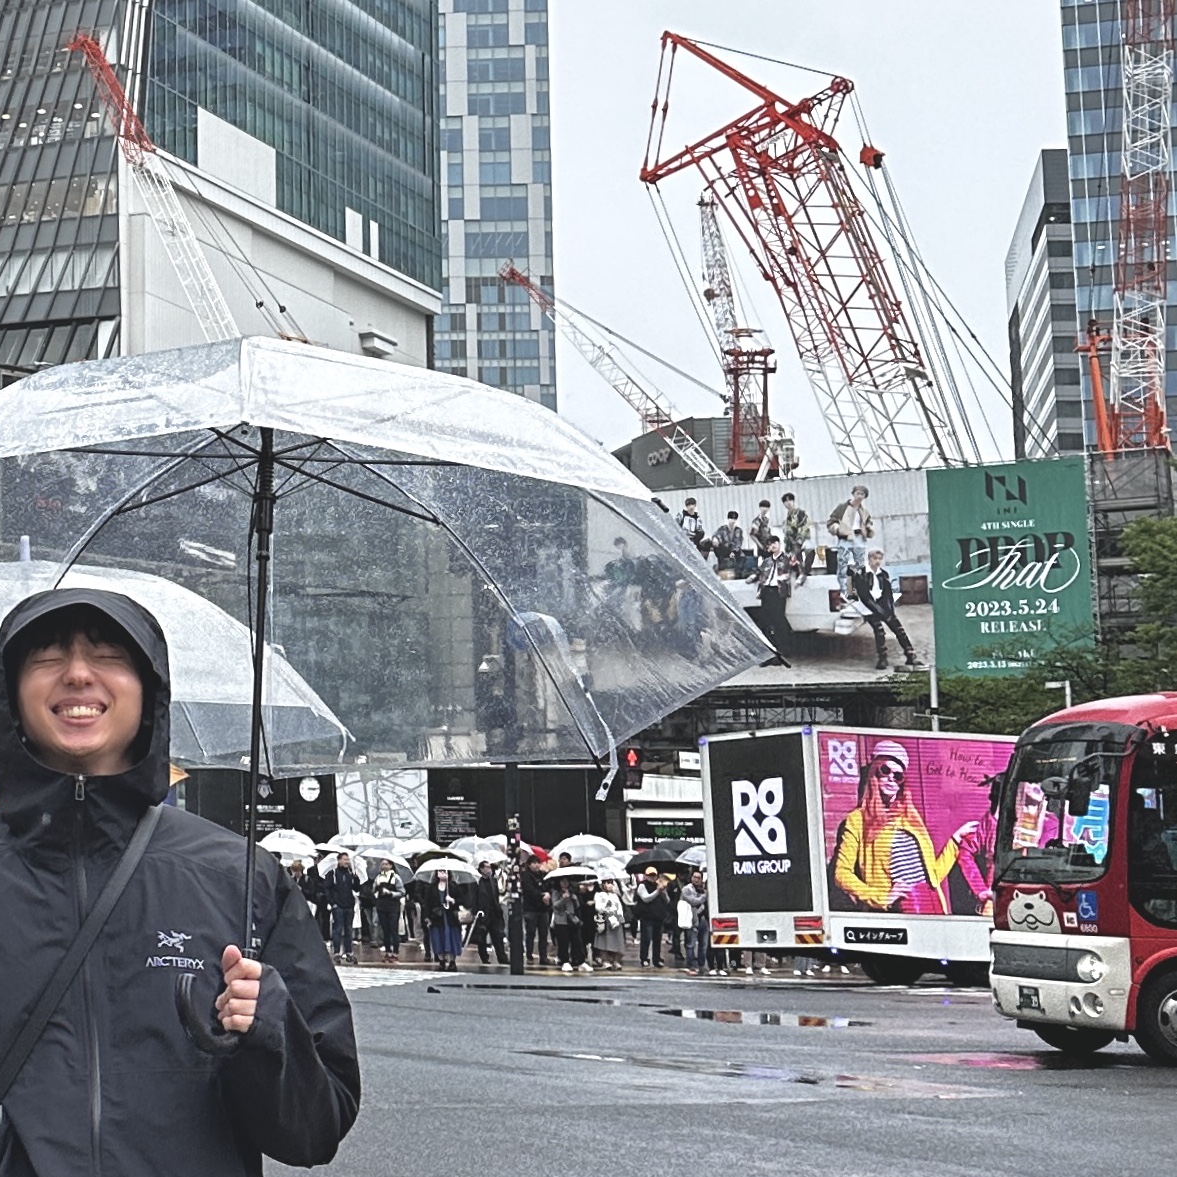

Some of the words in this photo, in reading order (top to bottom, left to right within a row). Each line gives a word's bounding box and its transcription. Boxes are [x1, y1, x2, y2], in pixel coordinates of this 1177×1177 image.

[980, 521, 1000, 530] 4TH
[1001, 519, 1035, 529] SINGLE
[942, 537, 1081, 594] That
[965, 598, 1061, 618] 2023.5.24
[733, 860, 756, 875] RAIN
[757, 859, 791, 874] GROUP
